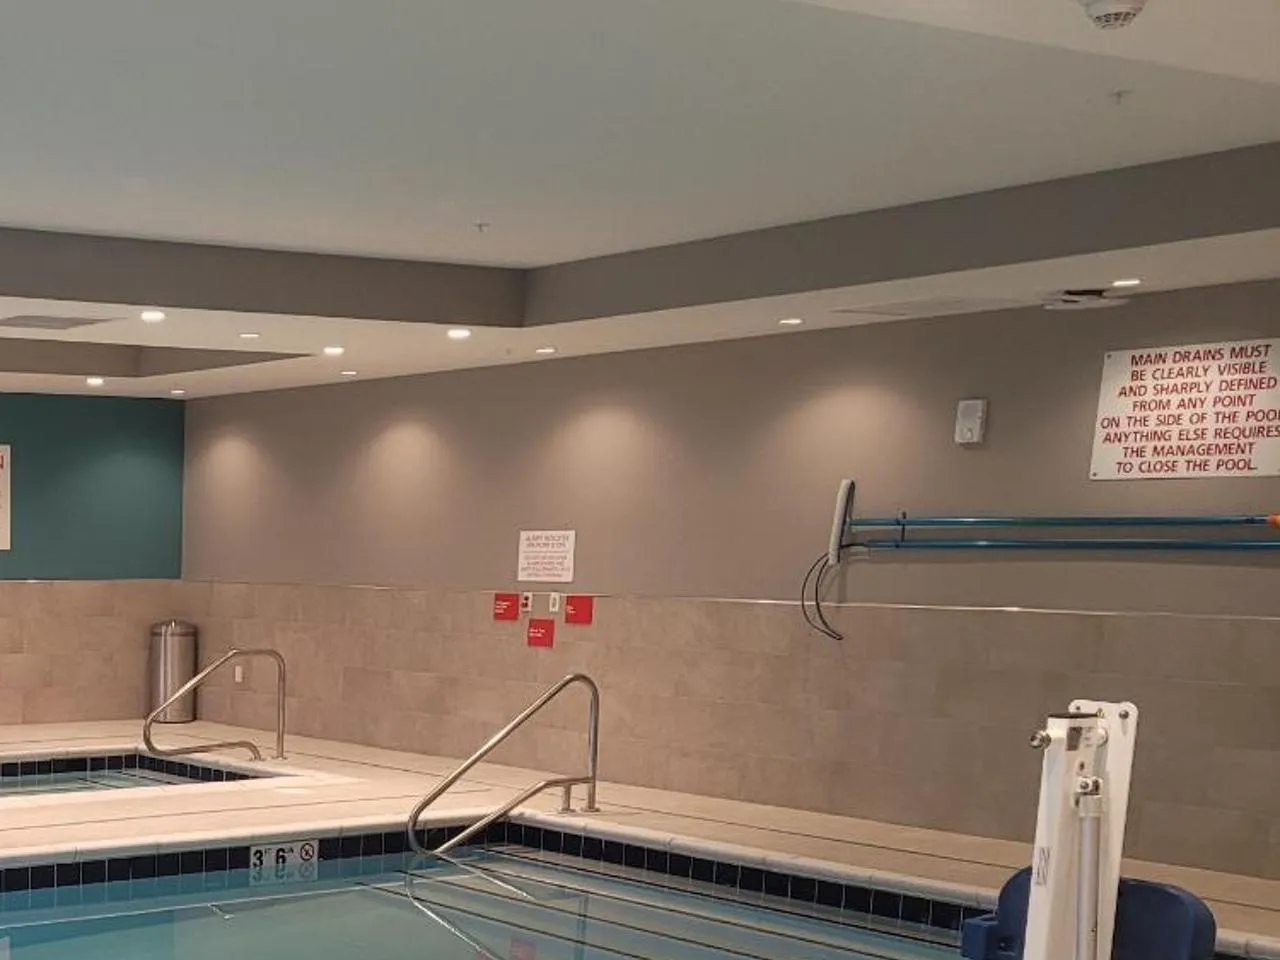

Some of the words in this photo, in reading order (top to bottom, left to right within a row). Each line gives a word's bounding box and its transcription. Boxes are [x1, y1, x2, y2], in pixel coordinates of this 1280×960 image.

[1131, 353, 1167, 366] MAIN
[1172, 348, 1225, 364] DRAINS
[1230, 344, 1272, 359] MUST
[1131, 369, 1146, 382] BE
[1152, 365, 1211, 380] CLEARLY
[1218, 361, 1267, 376] VISIBLE
[1118, 385, 1148, 398] AND
[1153, 381, 1213, 396] SHARPLY
[1219, 377, 1278, 392] DEFINED
[1133, 400, 1170, 412] FROM
[1175, 398, 1207, 410] ANY
[1213, 393, 1257, 408] POINT
[1100, 417, 1120, 429] ON
[1127, 415, 1149, 428] THE
[1155, 413, 1183, 426] SIDE
[1189, 412, 1207, 425] OF
[1214, 411, 1241, 424] THE
[1245, 408, 1280, 422] POO
[1102, 429, 1172, 444] ANYTHING
[1178, 427, 1207, 441] ELSE
[1214, 425, 1280, 441] REQUIRES
[1122, 446, 1146, 458] THE
[1152, 442, 1257, 457] MANAGEMENT
[1116, 461, 1134, 474] TO
[1138, 460, 1178, 473] CLOSE
[1185, 459, 1210, 471] THE
[1216, 458, 1258, 471] POOL
